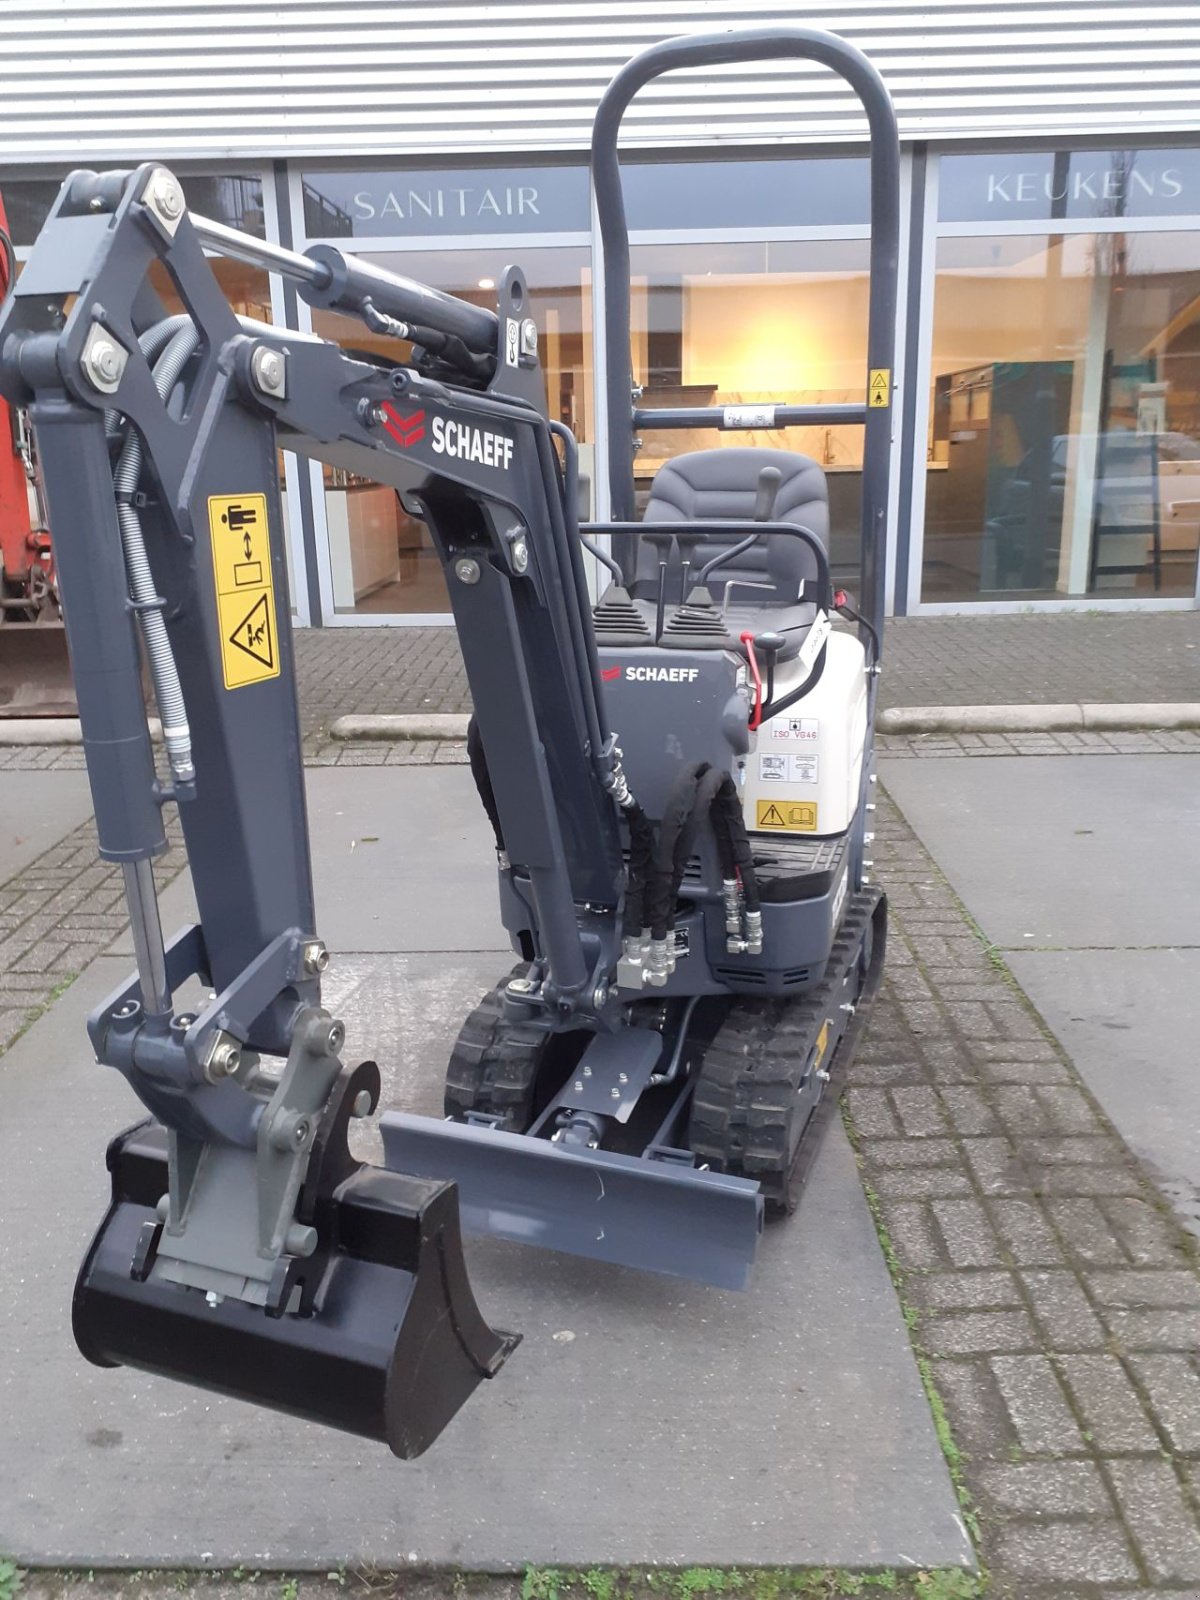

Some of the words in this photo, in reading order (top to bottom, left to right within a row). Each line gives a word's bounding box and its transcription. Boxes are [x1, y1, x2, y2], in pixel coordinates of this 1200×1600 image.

[987, 168, 1183, 202] KEUKENS
[353, 187, 541, 220] SANITAIR
[432, 416, 514, 470] SCHAEFF
[625, 666, 699, 682] SCHAEFF
[773, 730, 790, 738] ISO
[795, 731, 817, 739] VG46
